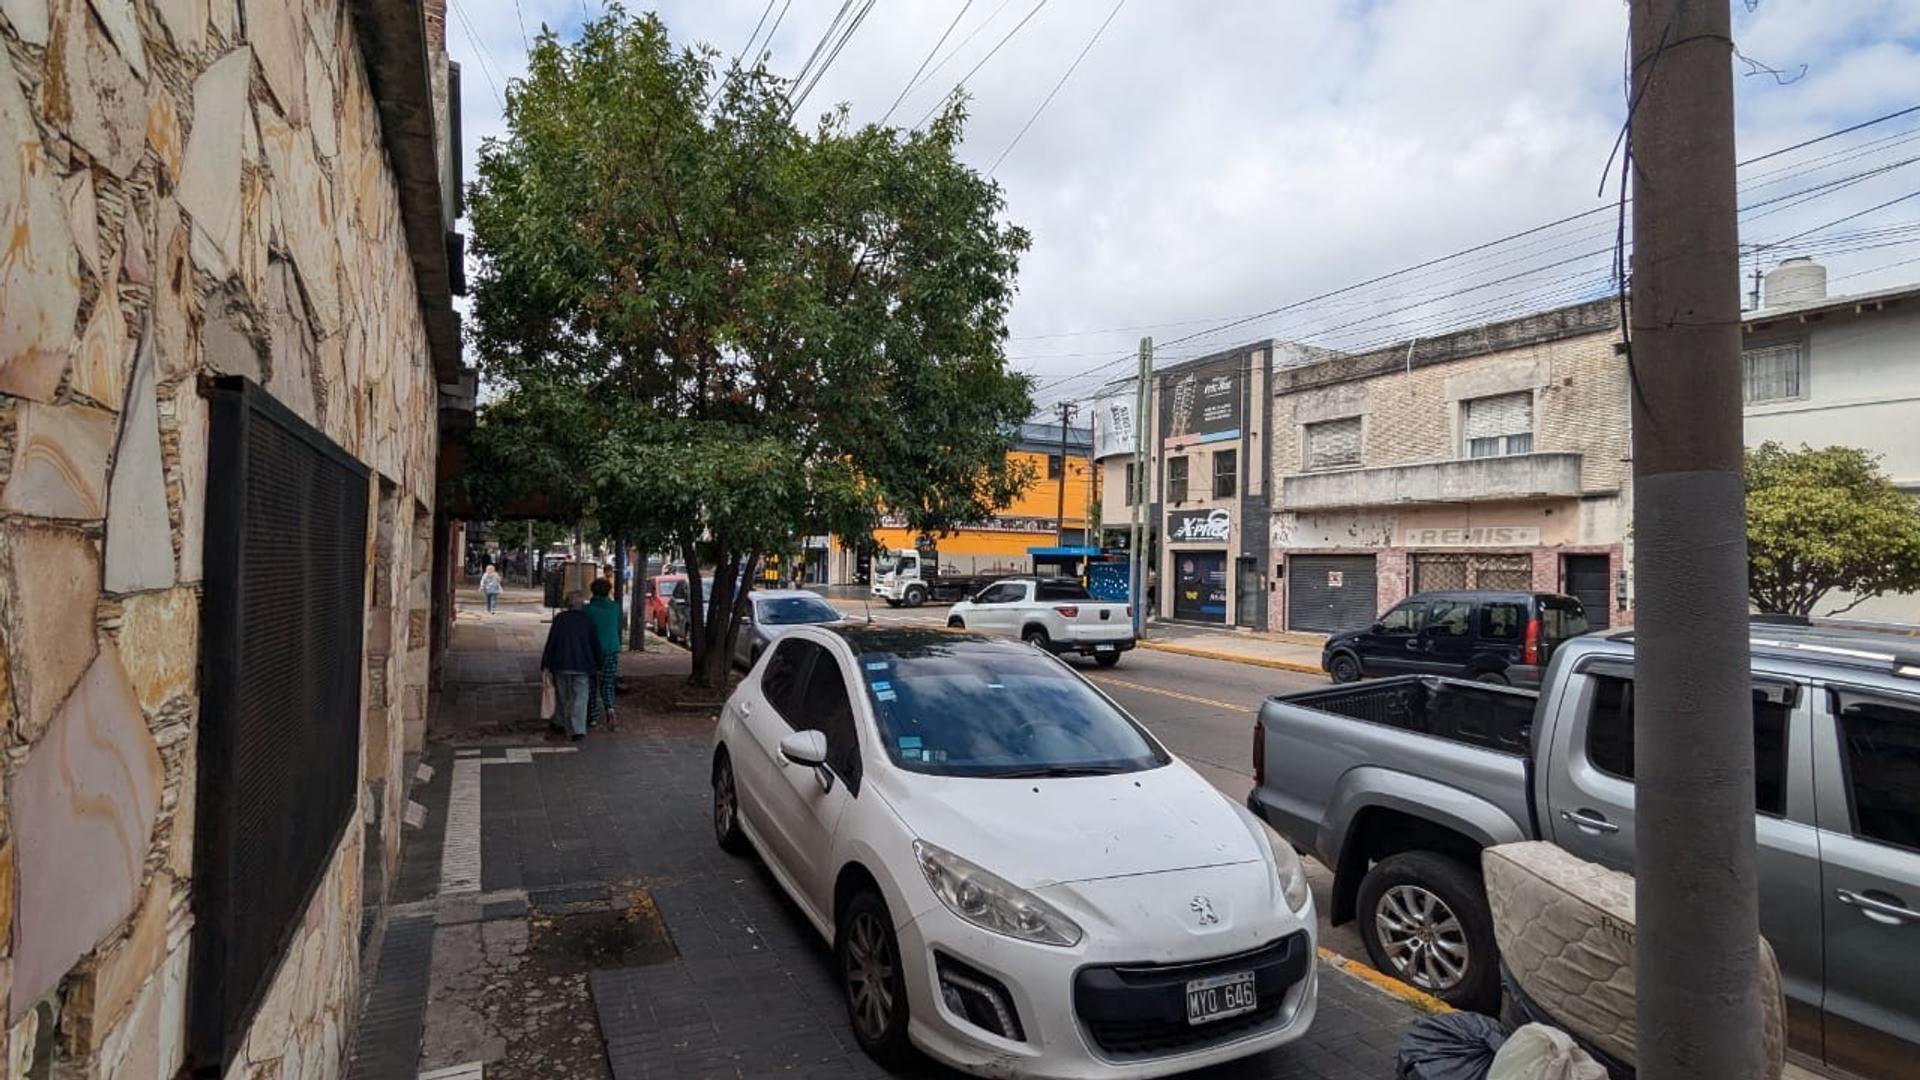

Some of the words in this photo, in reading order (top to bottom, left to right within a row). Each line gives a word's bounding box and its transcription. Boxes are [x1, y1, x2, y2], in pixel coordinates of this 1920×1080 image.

[1420, 528, 1513, 545] REMIS
[1189, 988, 1218, 1017] MYO
[1225, 982, 1253, 1008] 646
